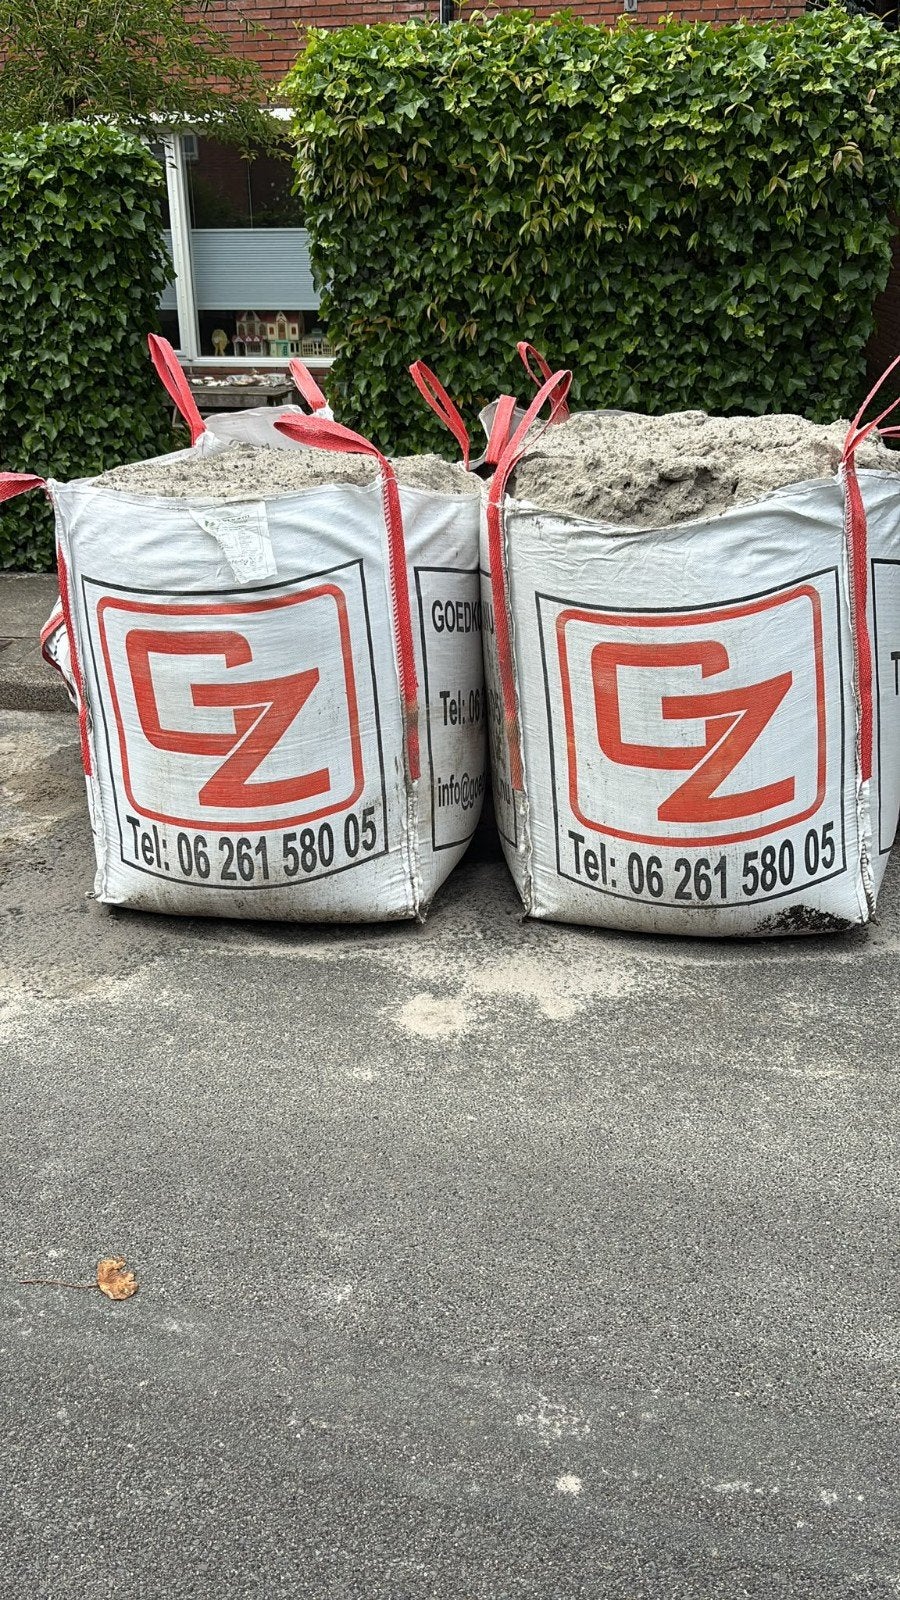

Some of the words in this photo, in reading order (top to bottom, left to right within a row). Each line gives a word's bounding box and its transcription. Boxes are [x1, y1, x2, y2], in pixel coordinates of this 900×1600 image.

[439, 690, 465, 726] Tel:
[126, 814, 170, 871] Tel:
[177, 832, 211, 879] 06
[218, 836, 270, 881] 261
[282, 822, 334, 877] 580
[344, 806, 377, 858] 05
[568, 829, 617, 888] Tel:
[627, 852, 664, 898] 06
[674, 855, 727, 900] 261
[742, 839, 795, 896] 580
[804, 820, 835, 875] 05
